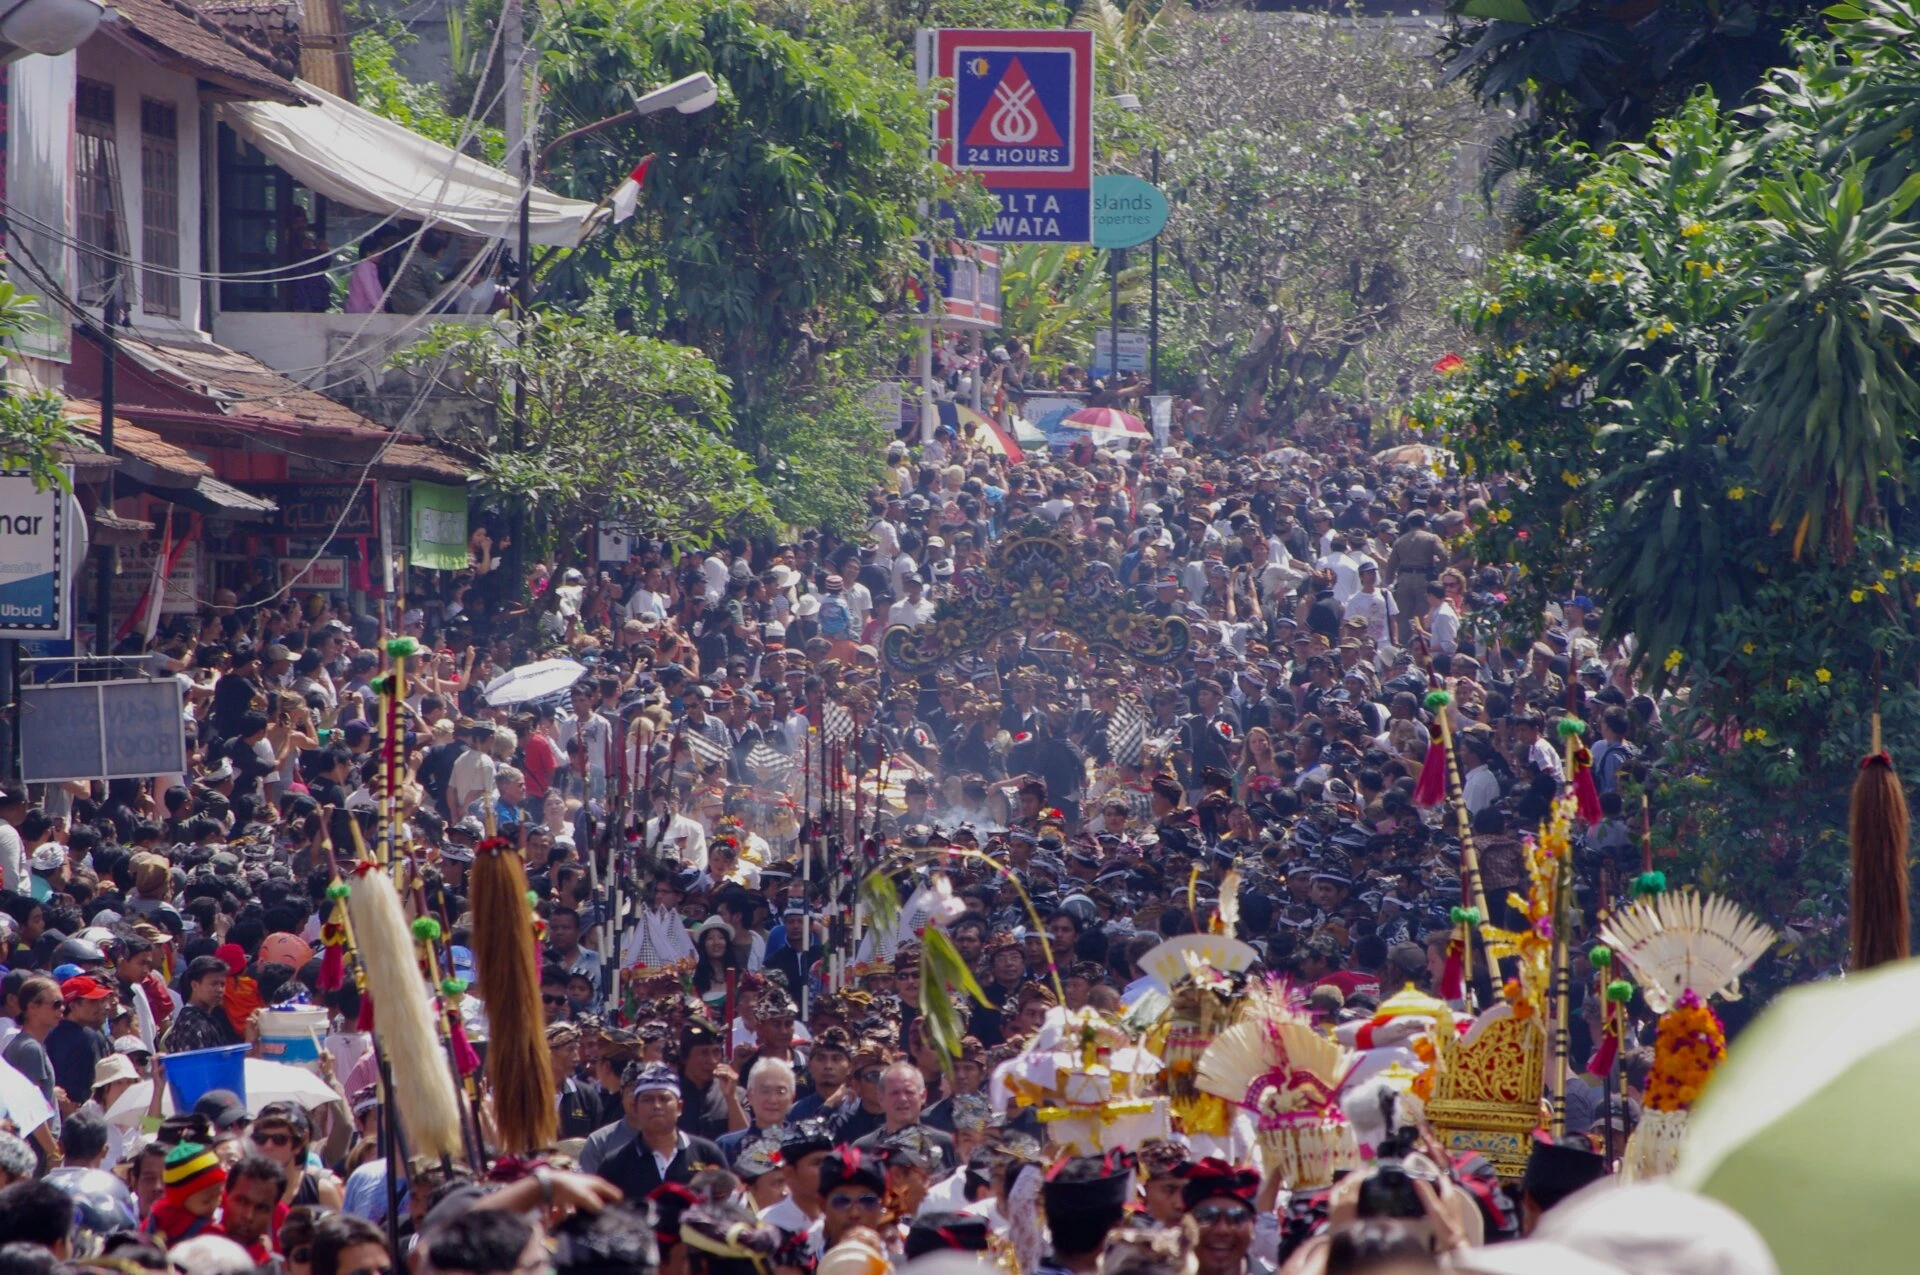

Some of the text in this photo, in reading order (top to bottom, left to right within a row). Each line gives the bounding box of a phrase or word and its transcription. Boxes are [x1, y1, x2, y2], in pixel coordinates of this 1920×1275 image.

[968, 149, 1060, 163] 24 HOURS
[1094, 193, 1153, 210] slands
[982, 217, 1060, 236] WATA
[1093, 214, 1151, 226] roperties
[0, 513, 43, 536] nar
[1, 604, 43, 618] Ubud
